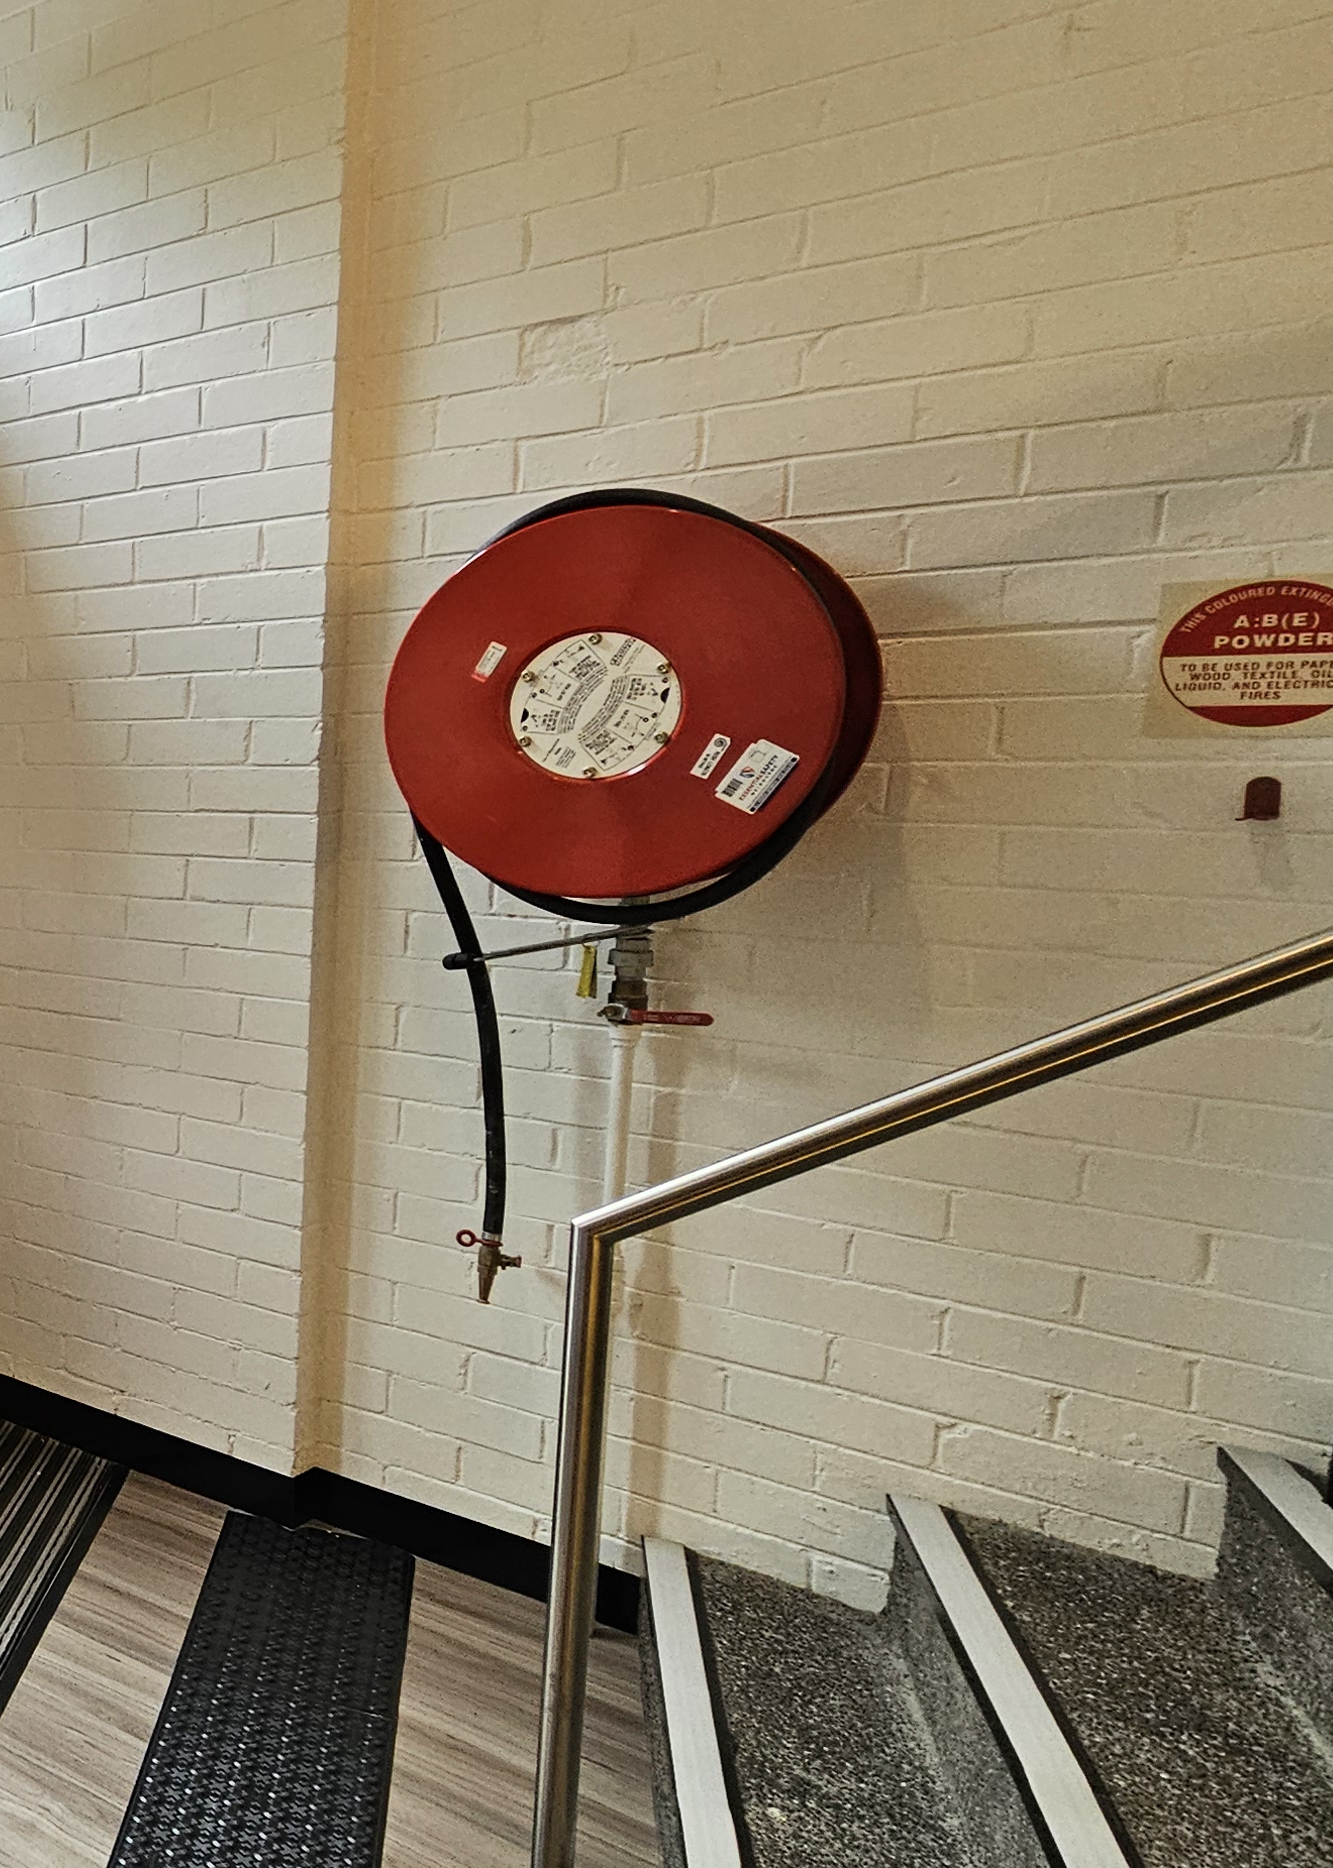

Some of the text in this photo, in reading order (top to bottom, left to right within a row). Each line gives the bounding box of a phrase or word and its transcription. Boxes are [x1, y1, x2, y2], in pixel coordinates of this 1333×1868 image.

[1179, 612, 1207, 633] THIS
[1204, 586, 1275, 614] COLOURED
[1233, 612, 1320, 629] A:B(E)
[1213, 632, 1333, 649] POWDER
[1180, 663, 1197, 672] TO
[1202, 662, 1219, 672] BE
[1224, 661, 1260, 672] USED
[1266, 661, 1295, 670] FOR
[1232, 681, 1261, 690] AND
[1240, 690, 1282, 700] FIRES
